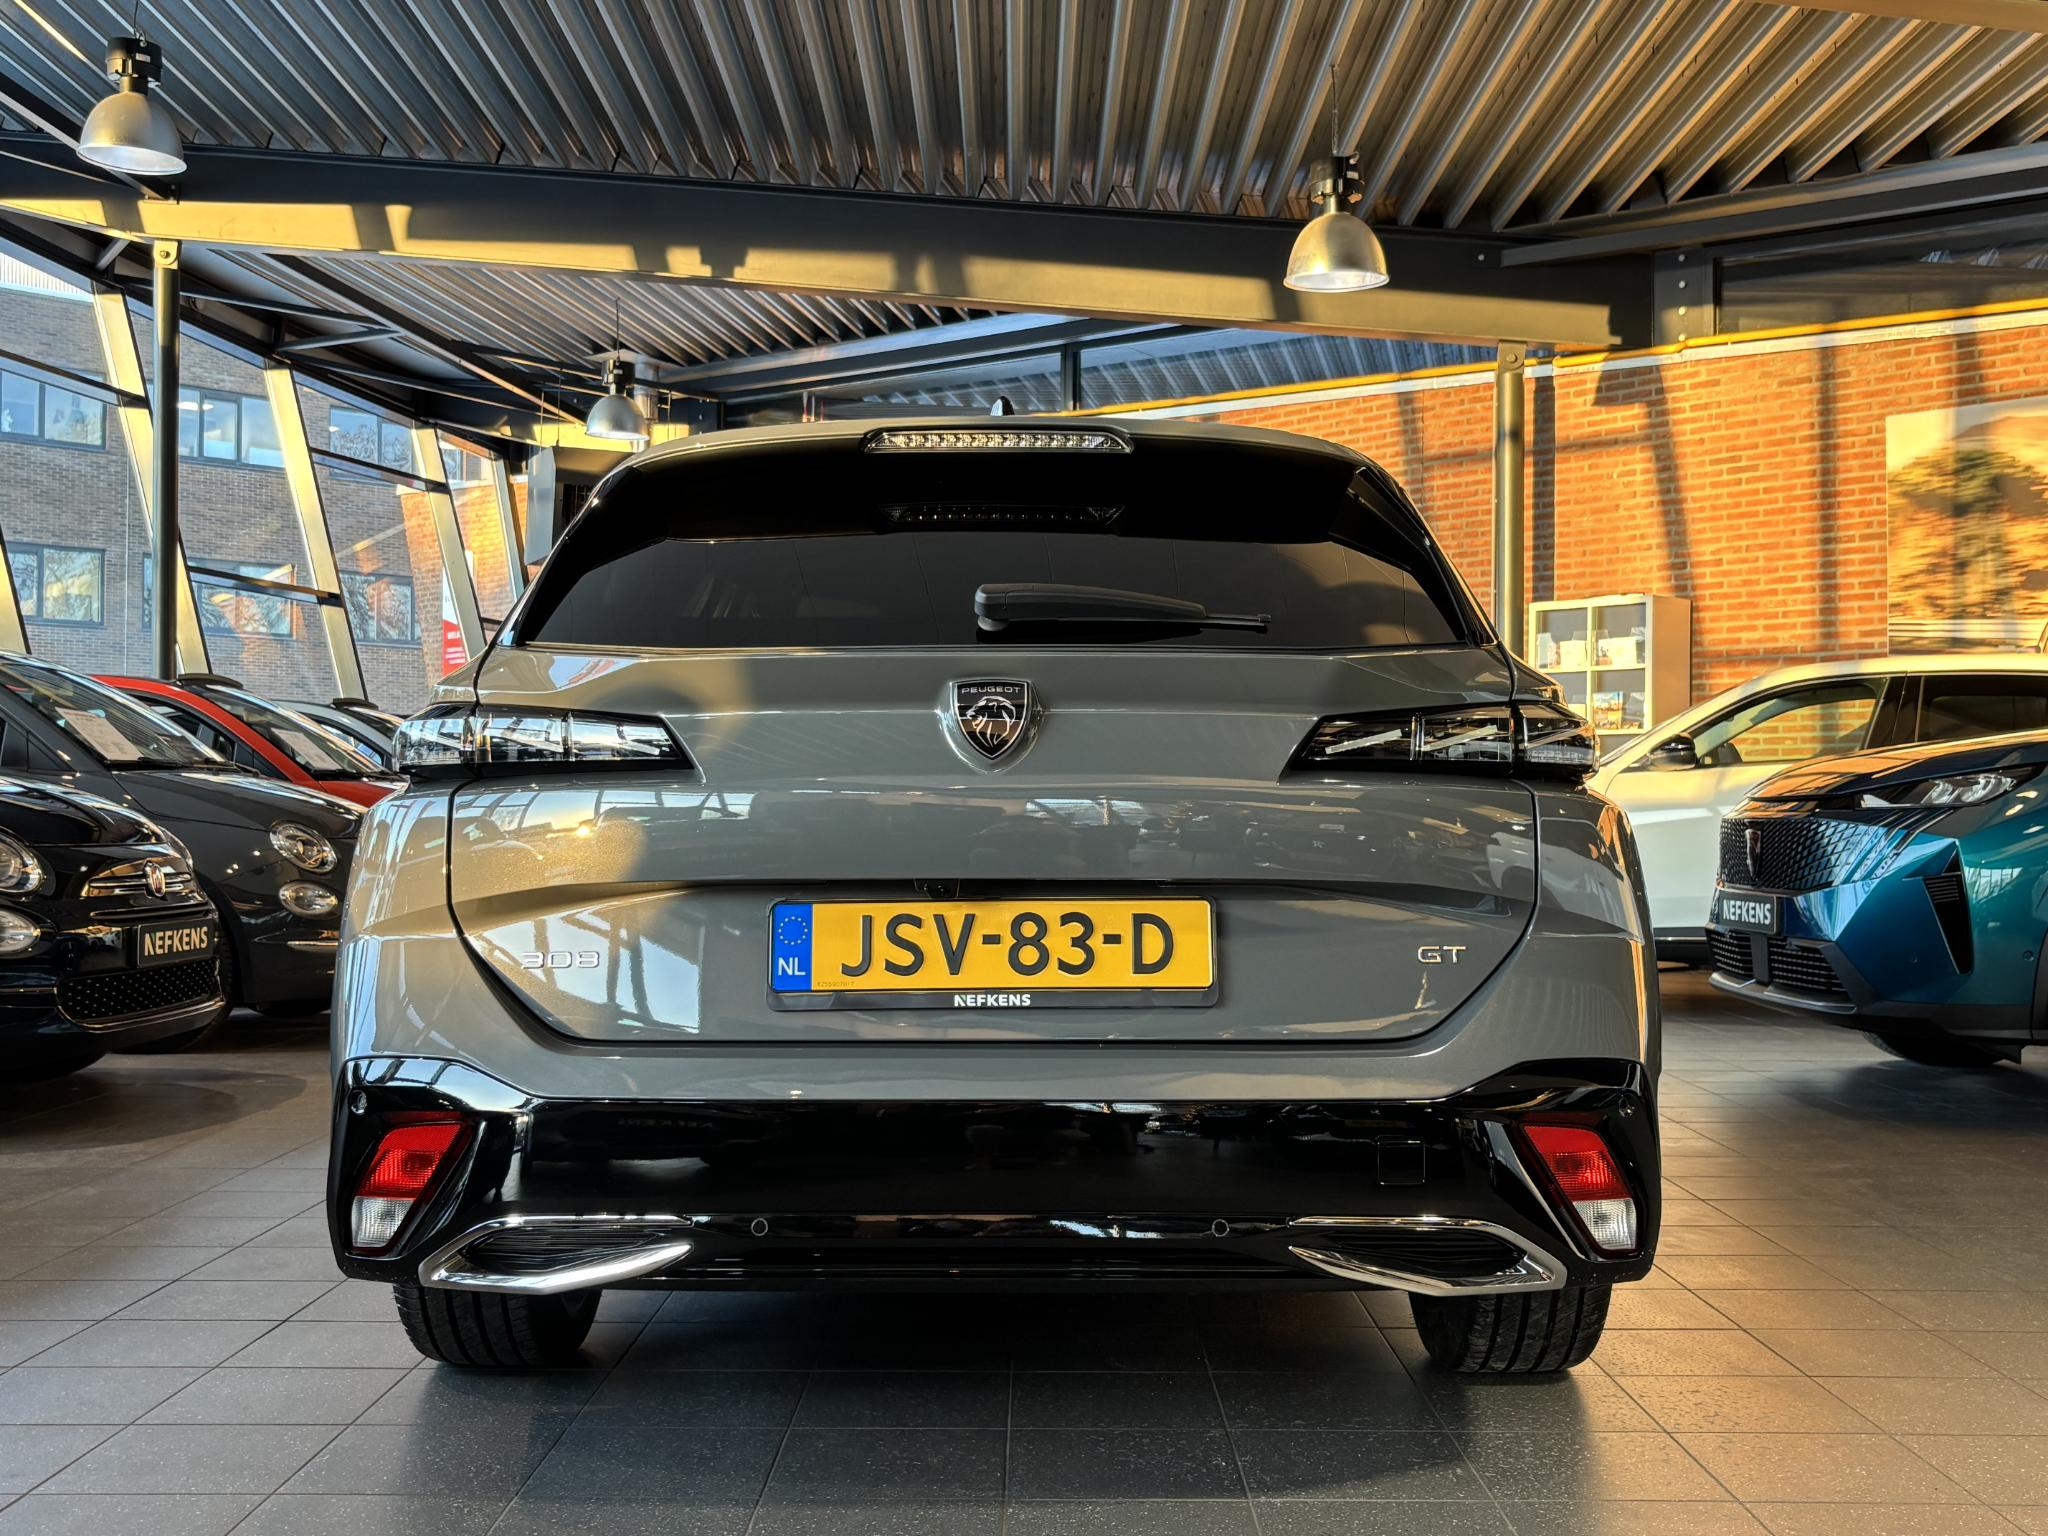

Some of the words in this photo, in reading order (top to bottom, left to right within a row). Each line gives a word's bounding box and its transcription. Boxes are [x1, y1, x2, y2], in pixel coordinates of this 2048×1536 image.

[961, 685, 1021, 694] PEUGEOT
[1723, 899, 1771, 925] NEFKENS
[144, 926, 208, 956] NEFKENS
[840, 912, 1174, 977] JSV-83-D
[520, 951, 600, 969] 308
[1417, 945, 1467, 964] GT
[777, 957, 806, 976] NL
[954, 993, 1031, 1007] NEFKENS
